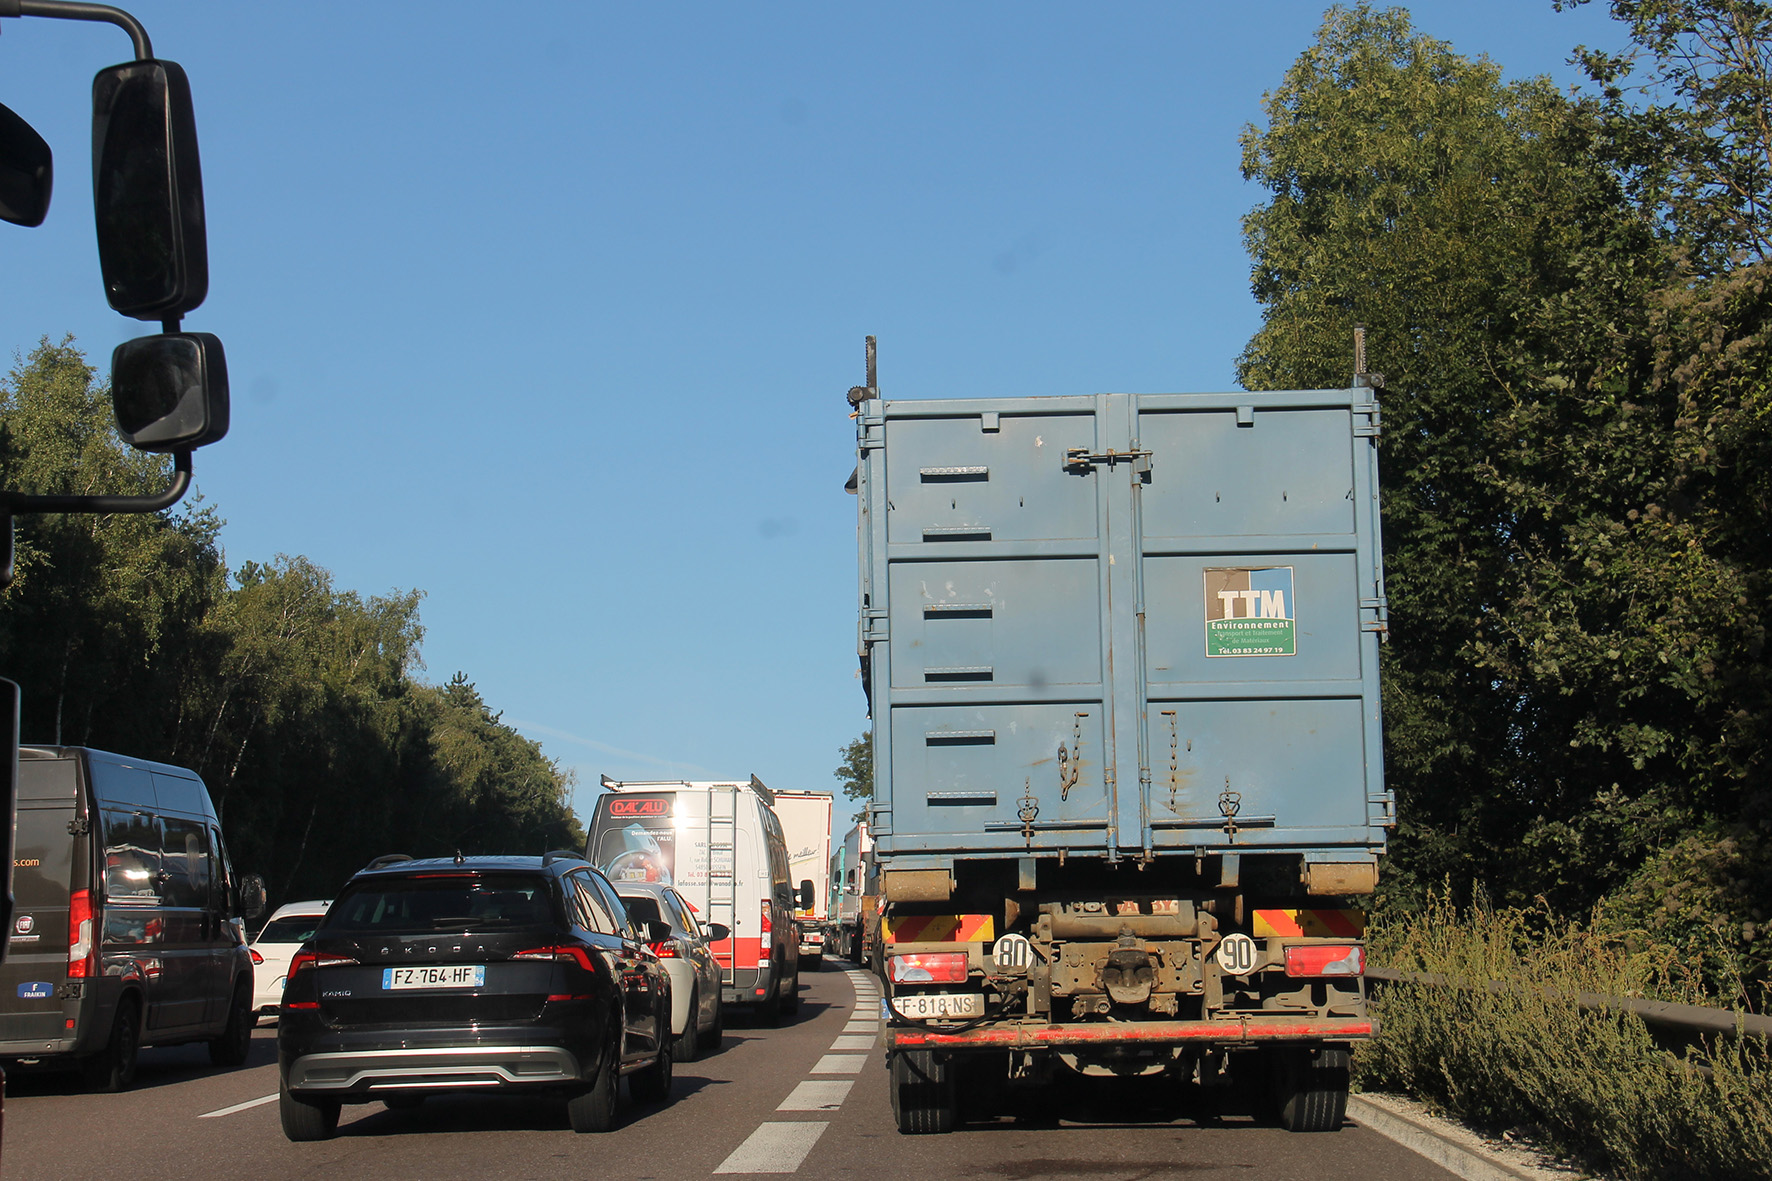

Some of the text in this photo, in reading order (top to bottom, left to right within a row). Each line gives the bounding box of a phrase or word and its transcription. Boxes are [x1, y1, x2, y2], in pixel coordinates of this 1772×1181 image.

[1217, 590, 1285, 619] TTM
[1211, 621, 1289, 630] Environnement
[14, 859, 40, 867] s.com
[999, 937, 1027, 967] 80
[1223, 938, 1252, 969] 90
[395, 967, 472, 985] FZ-764-HF
